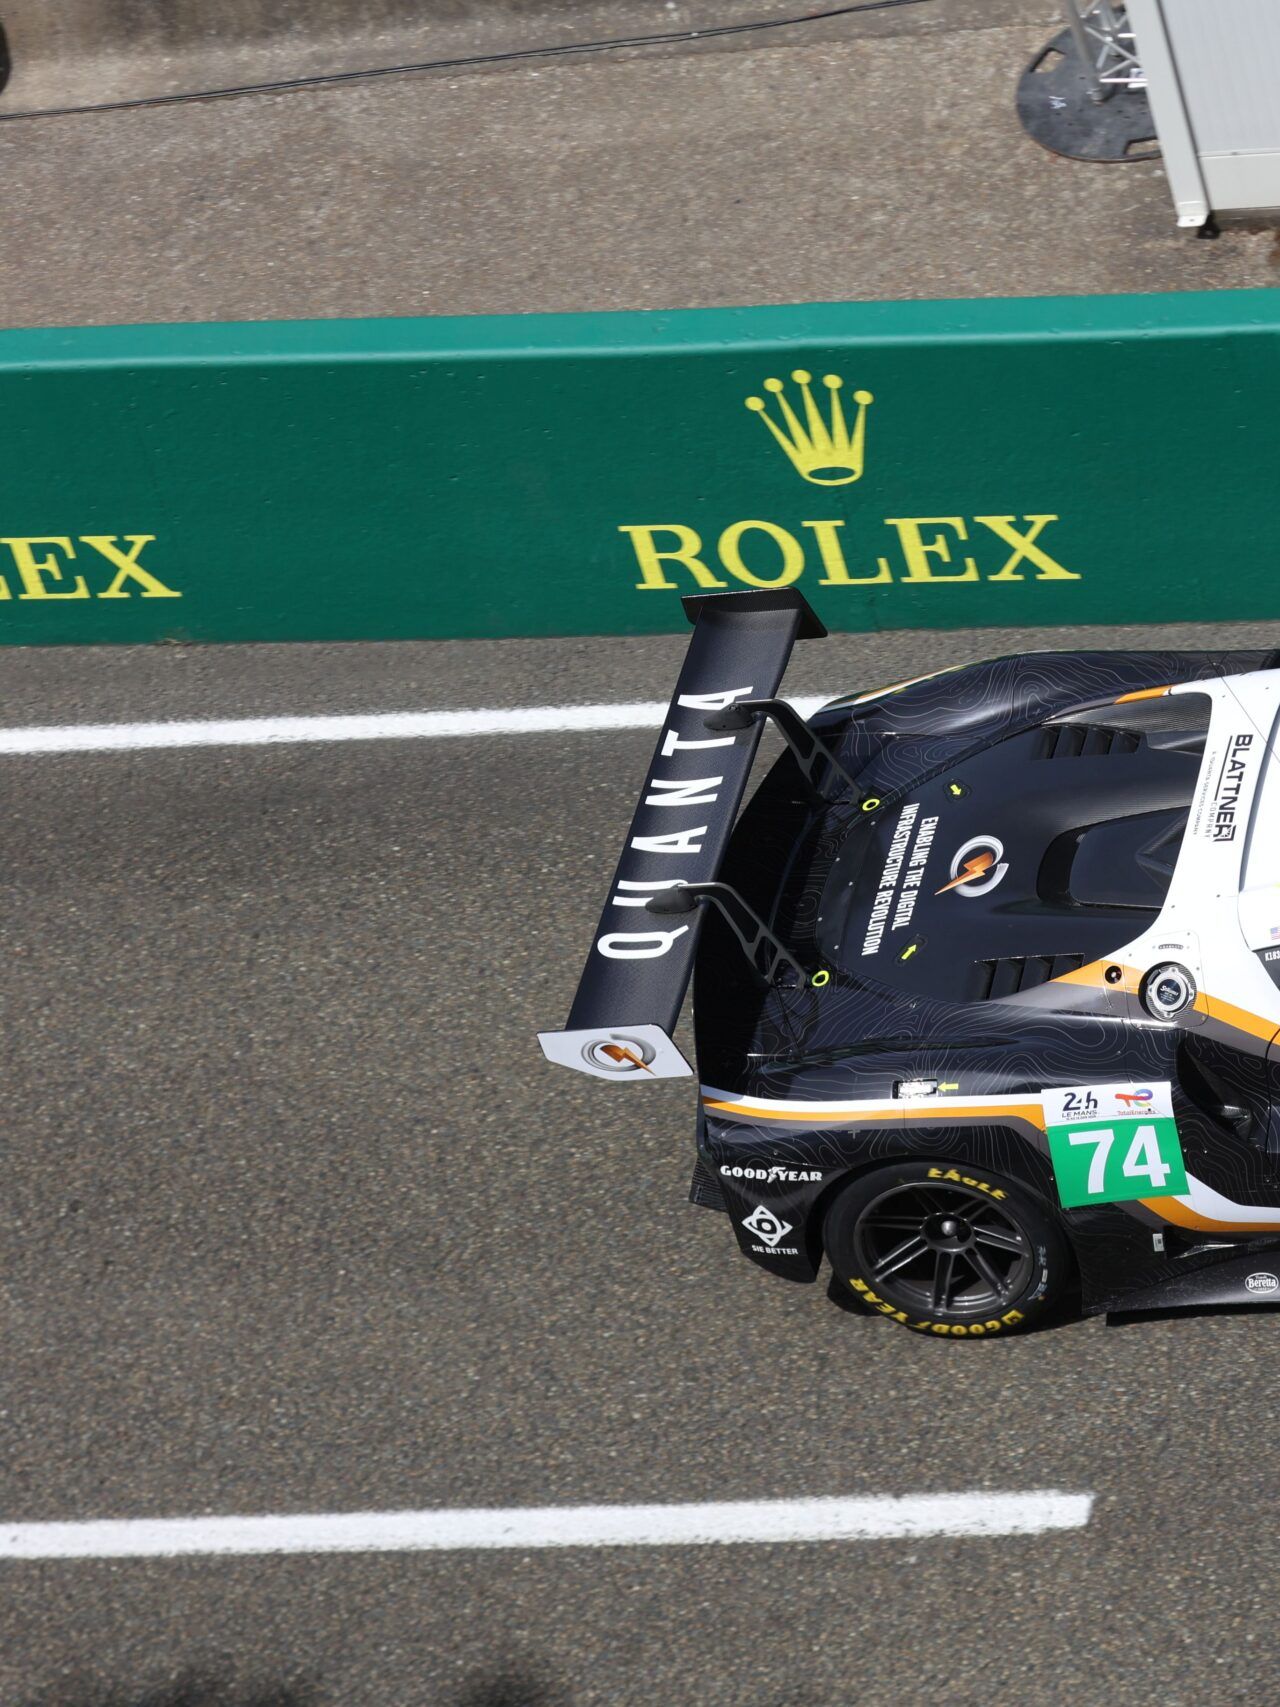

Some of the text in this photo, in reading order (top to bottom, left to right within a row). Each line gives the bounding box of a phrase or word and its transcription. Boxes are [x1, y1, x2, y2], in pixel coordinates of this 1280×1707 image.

[0, 535, 183, 599] EX
[617, 514, 1082, 589] ROLEX
[1212, 734, 1253, 842] BLATTNER
[597, 686, 753, 959] QUANTA
[861, 803, 920, 956] INFRASTRUCTURE REVOLUTION
[892, 816, 939, 931] ENABLING THE DIGITAL
[1062, 1091, 1098, 1111] 24h
[720, 1165, 823, 1183] GOODYEAR
[927, 1167, 1009, 1200] EAGLE
[1068, 1125, 1171, 1194] 74
[766, 1246, 799, 1255] BETTER
[1247, 1277, 1276, 1288] Beretta
[849, 1278, 1002, 1335] GOODYEAR
